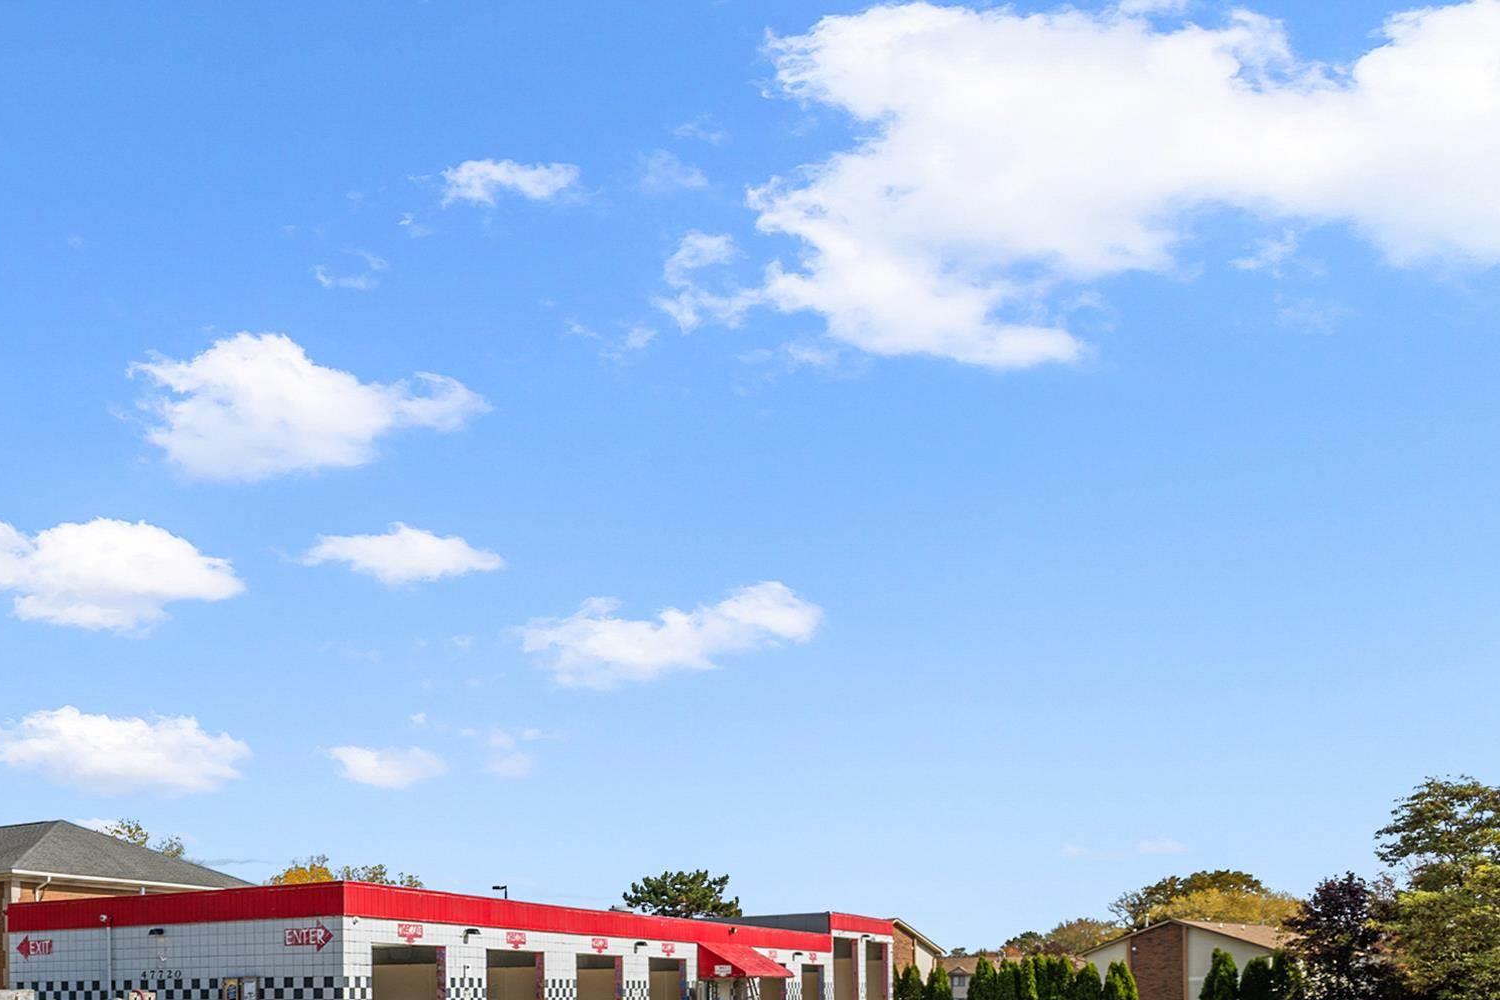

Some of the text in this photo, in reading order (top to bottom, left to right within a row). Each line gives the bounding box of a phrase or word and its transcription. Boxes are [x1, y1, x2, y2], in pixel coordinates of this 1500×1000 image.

[285, 928, 326, 945] ENTER
[29, 940, 50, 955] EXIT
[141, 969, 182, 980] 47720
